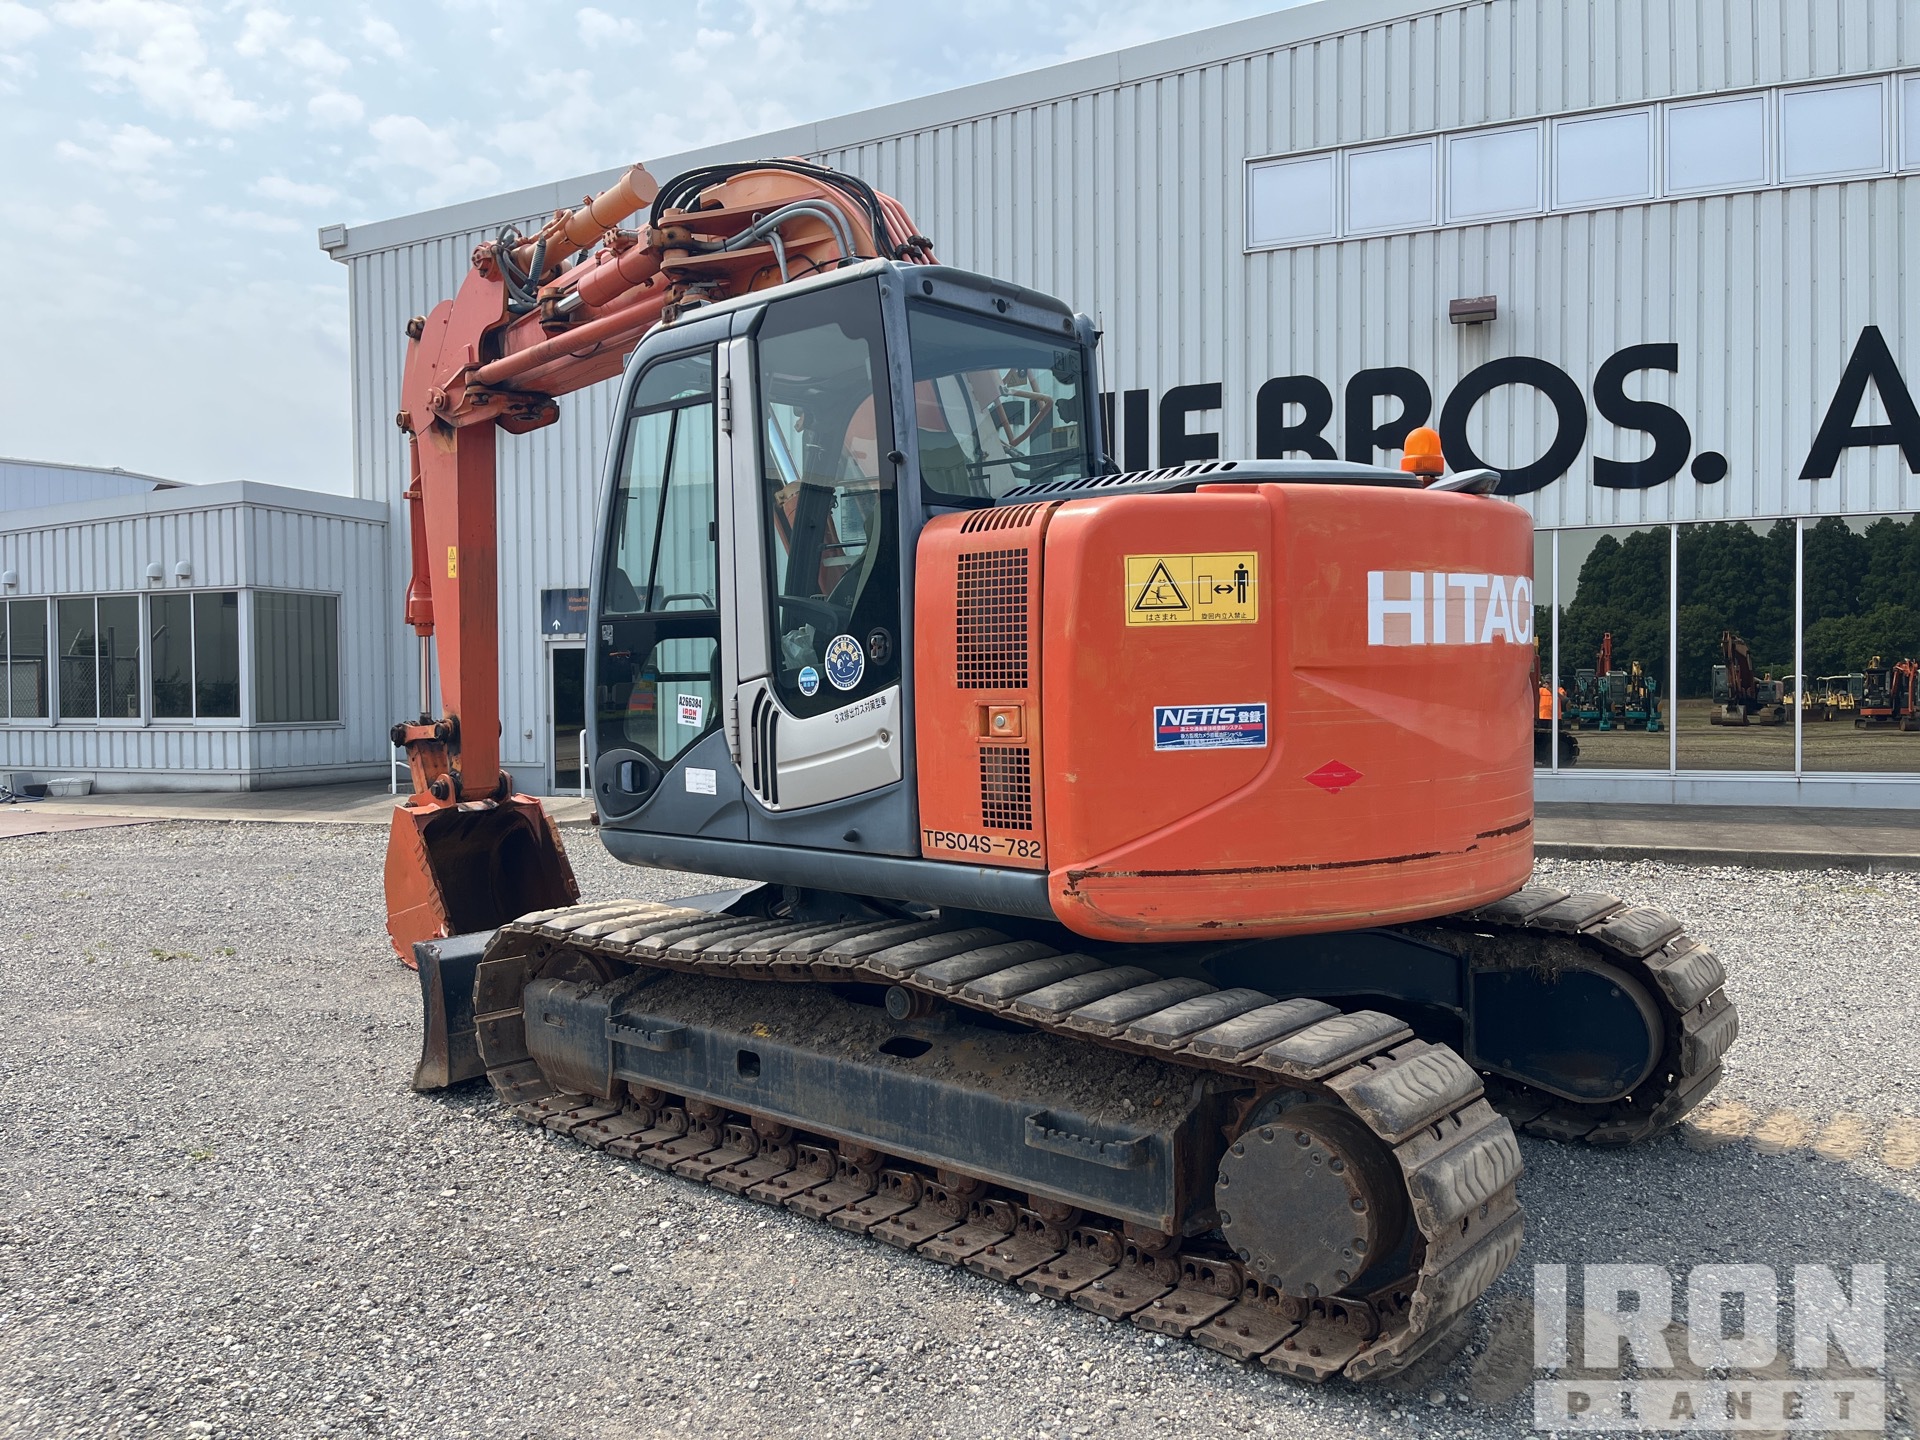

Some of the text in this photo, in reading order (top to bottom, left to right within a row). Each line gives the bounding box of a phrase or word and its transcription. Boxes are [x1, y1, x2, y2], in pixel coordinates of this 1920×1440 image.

[1256, 342, 1728, 496] BROS.
[1145, 613, 1177, 621] はさまれ
[683, 708, 697, 717] IRON
[1161, 708, 1237, 726] NETIS
[923, 829, 1041, 858] TPS04S-782
